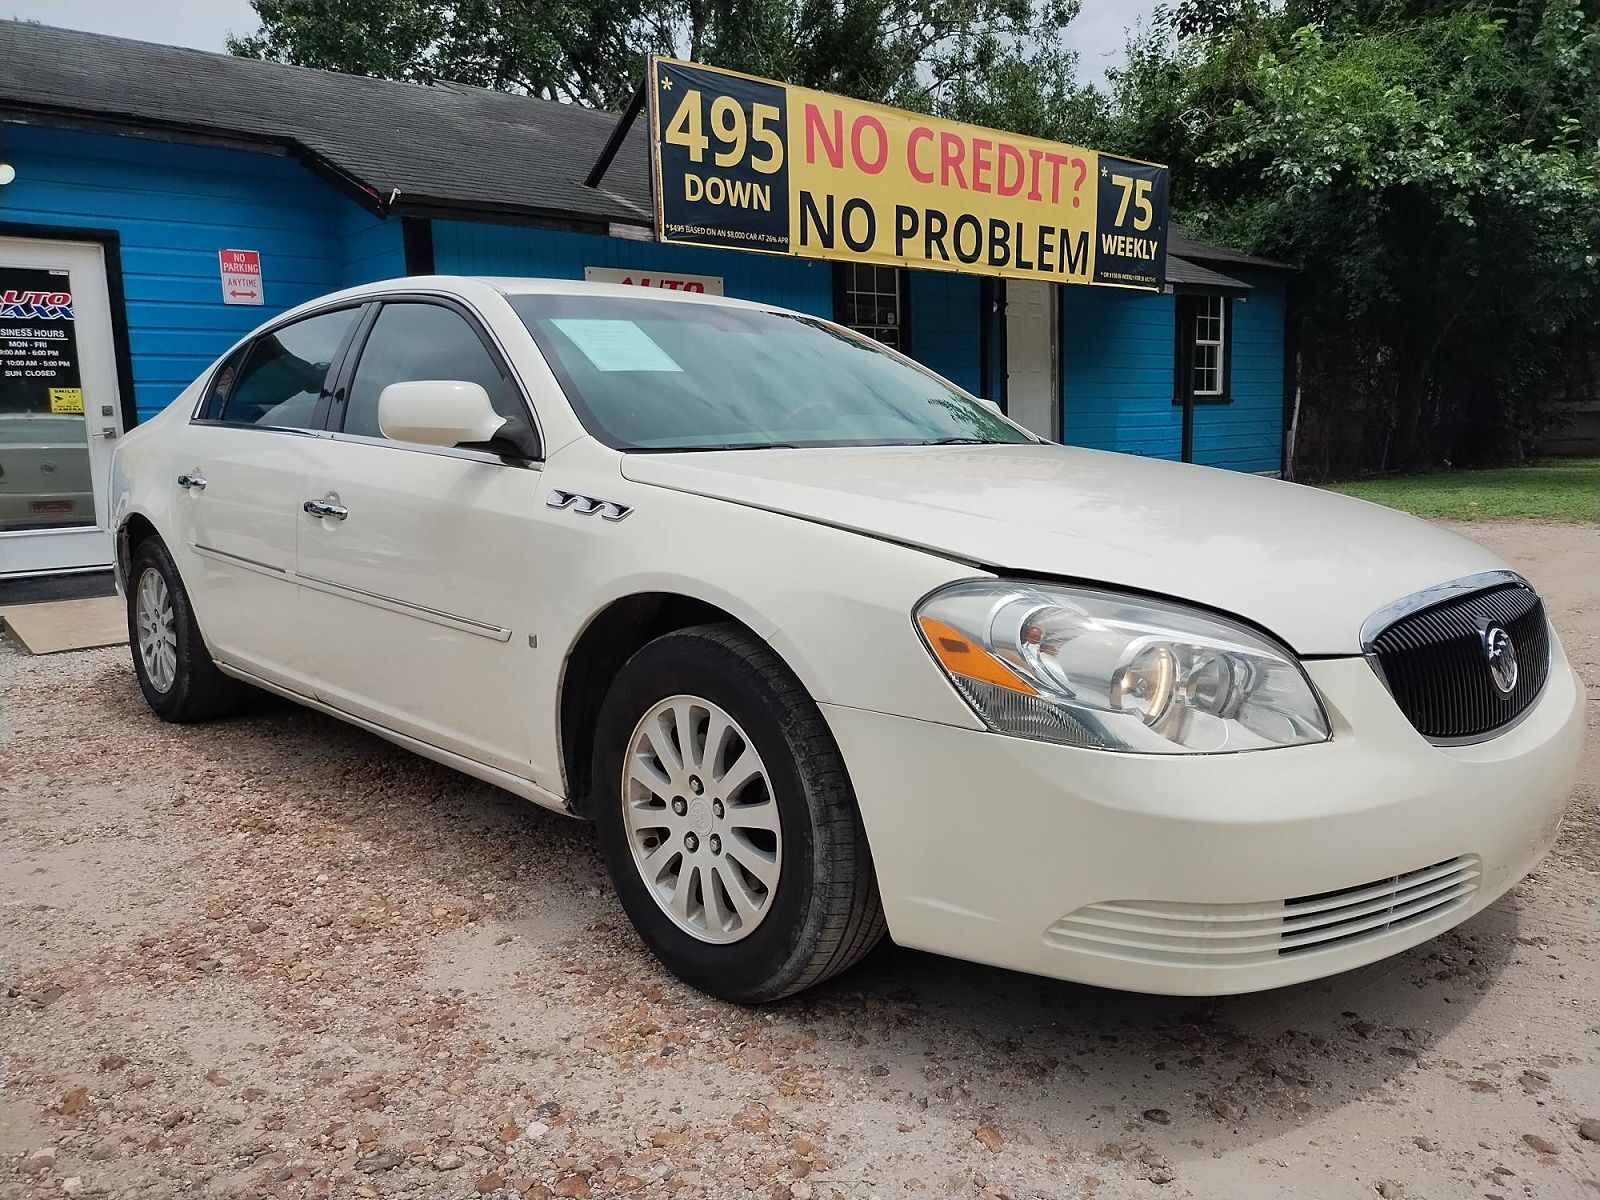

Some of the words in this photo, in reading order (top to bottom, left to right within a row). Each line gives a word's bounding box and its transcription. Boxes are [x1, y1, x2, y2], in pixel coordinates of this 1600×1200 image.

[665, 90, 784, 174] 495
[805, 103, 889, 175] NO
[907, 126, 1087, 209] CREDIT?
[684, 173, 771, 212] DOWN
[1111, 175, 1153, 232] 75
[685, 225, 706, 235] BASED
[706, 227, 717, 237] ON
[717, 228, 726, 238] AN
[745, 232, 758, 241] CAR
[757, 233, 766, 242] AT
[777, 235, 789, 244] APR
[799, 190, 876, 253] NO
[895, 204, 1090, 276] PROBLEM
[233, 252, 246, 263] NO
[1101, 233, 1158, 261] WEEKLY
[223, 262, 259, 273] PARKING
[227, 277, 257, 288] ANYTIME
[0, 303, 76, 321] AXX
[0, 328, 33, 337] SINESS
[33, 329, 65, 338] HOURS
